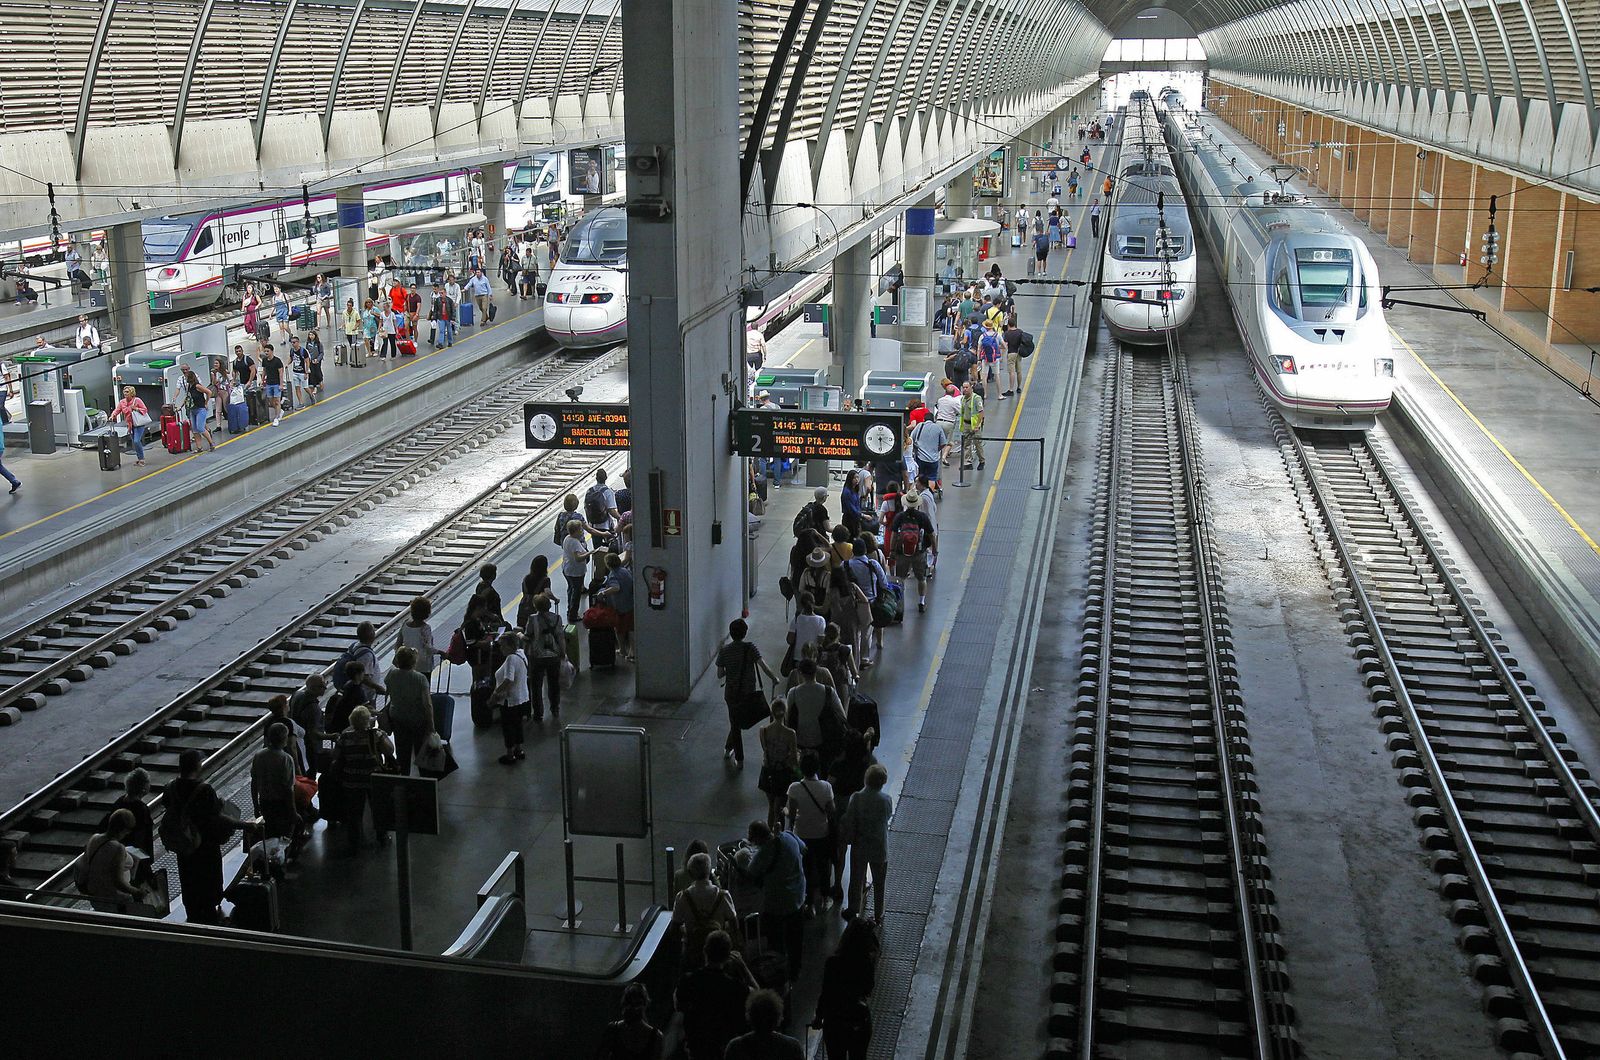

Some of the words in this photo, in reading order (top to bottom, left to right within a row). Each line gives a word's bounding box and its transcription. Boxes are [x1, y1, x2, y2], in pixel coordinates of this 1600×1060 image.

[222, 224, 250, 247] renfe
[559, 272, 602, 282] renfe
[90, 297, 97, 307] 5
[164, 299, 170, 308] 4
[804, 312, 811, 322] 3
[891, 315, 898, 325] 2
[562, 414, 585, 422] 14:50
[588, 414, 628, 423] AVE-03941
[773, 421, 797, 430] 14:45
[800, 422, 842, 432] AVE-02141
[571, 428, 611, 437] BARCELONA
[751, 434, 762, 452] 2
[775, 435, 804, 445] MADRID
[807, 436, 826, 446] PTA.
[830, 437, 859, 447] ATOCHA
[782, 446, 802, 454] PARA
[805, 446, 815, 455] EN
[819, 446, 852, 456] CORDOBA
